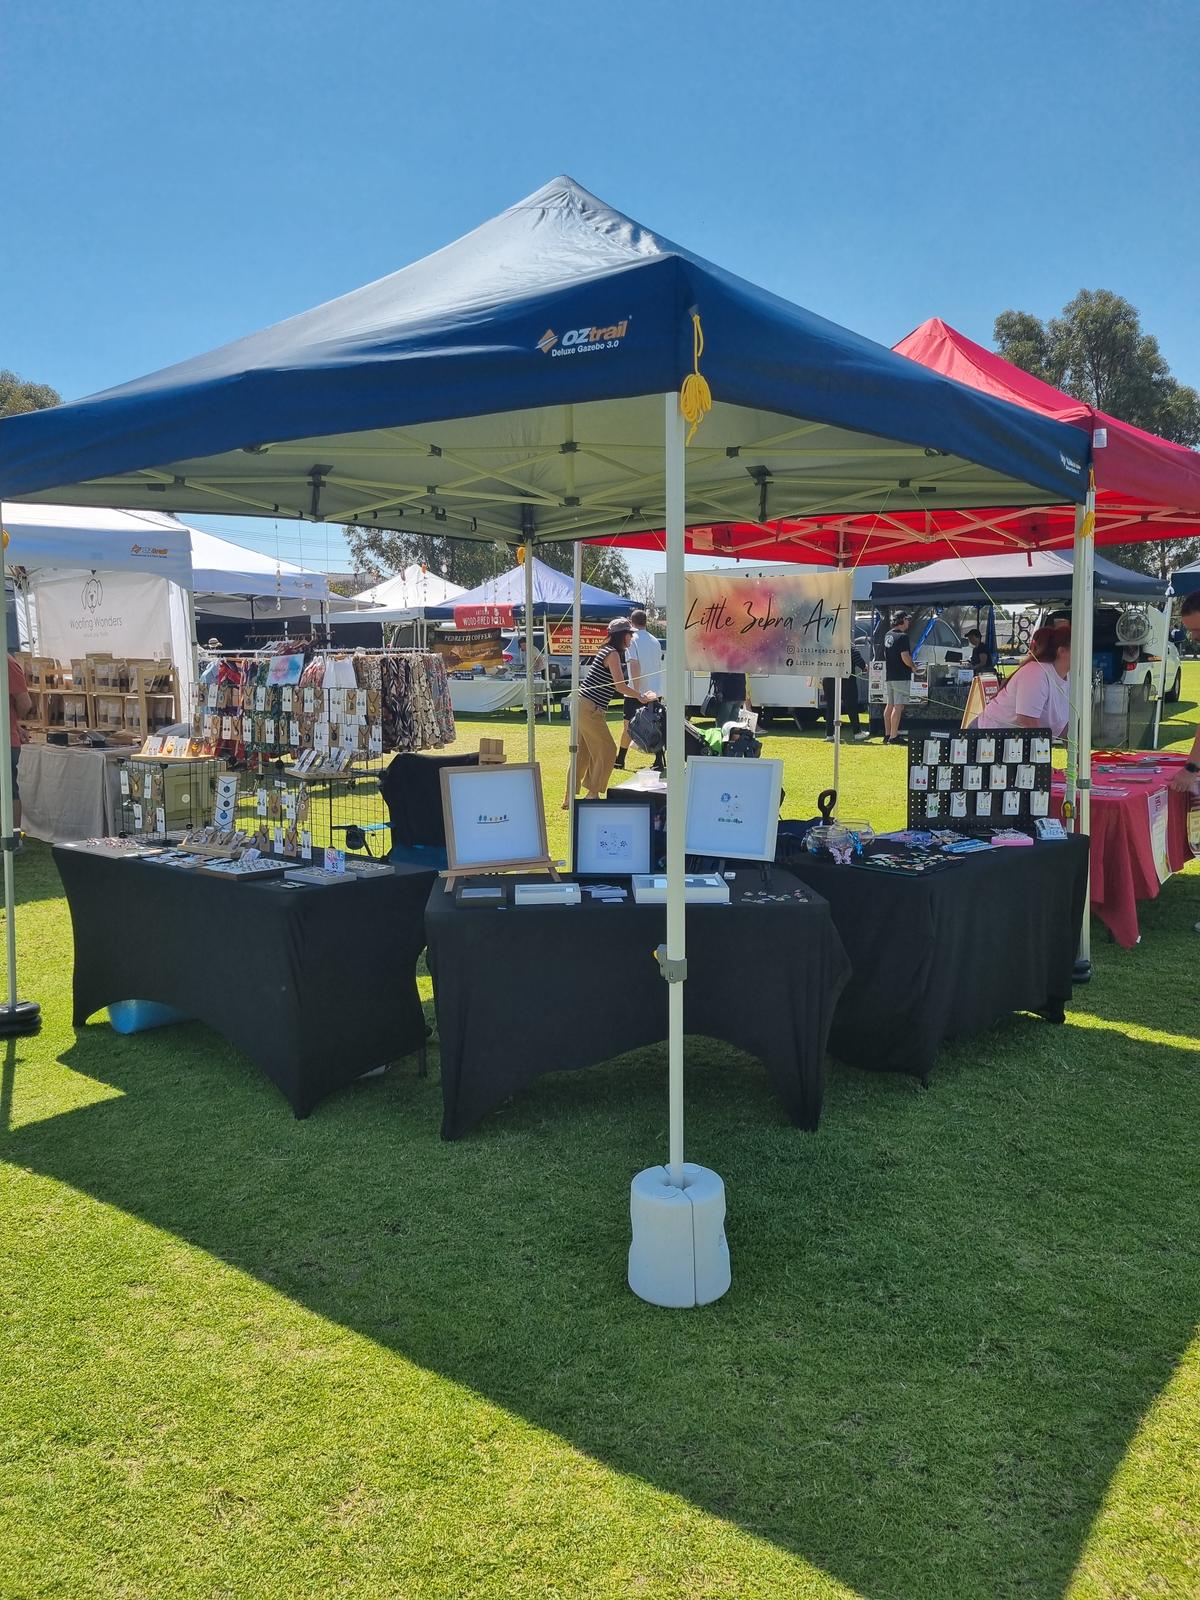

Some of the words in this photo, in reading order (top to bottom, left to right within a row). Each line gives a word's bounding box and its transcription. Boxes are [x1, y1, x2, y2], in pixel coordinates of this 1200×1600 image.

[551, 348, 576, 357] Deluxe
[577, 343, 605, 353] Gazebo
[606, 340, 619, 349] 3.0
[94, 616, 122, 628] Wonders
[684, 598, 734, 633] Little
[740, 597, 794, 634] Zebra
[802, 598, 849, 642] Art
